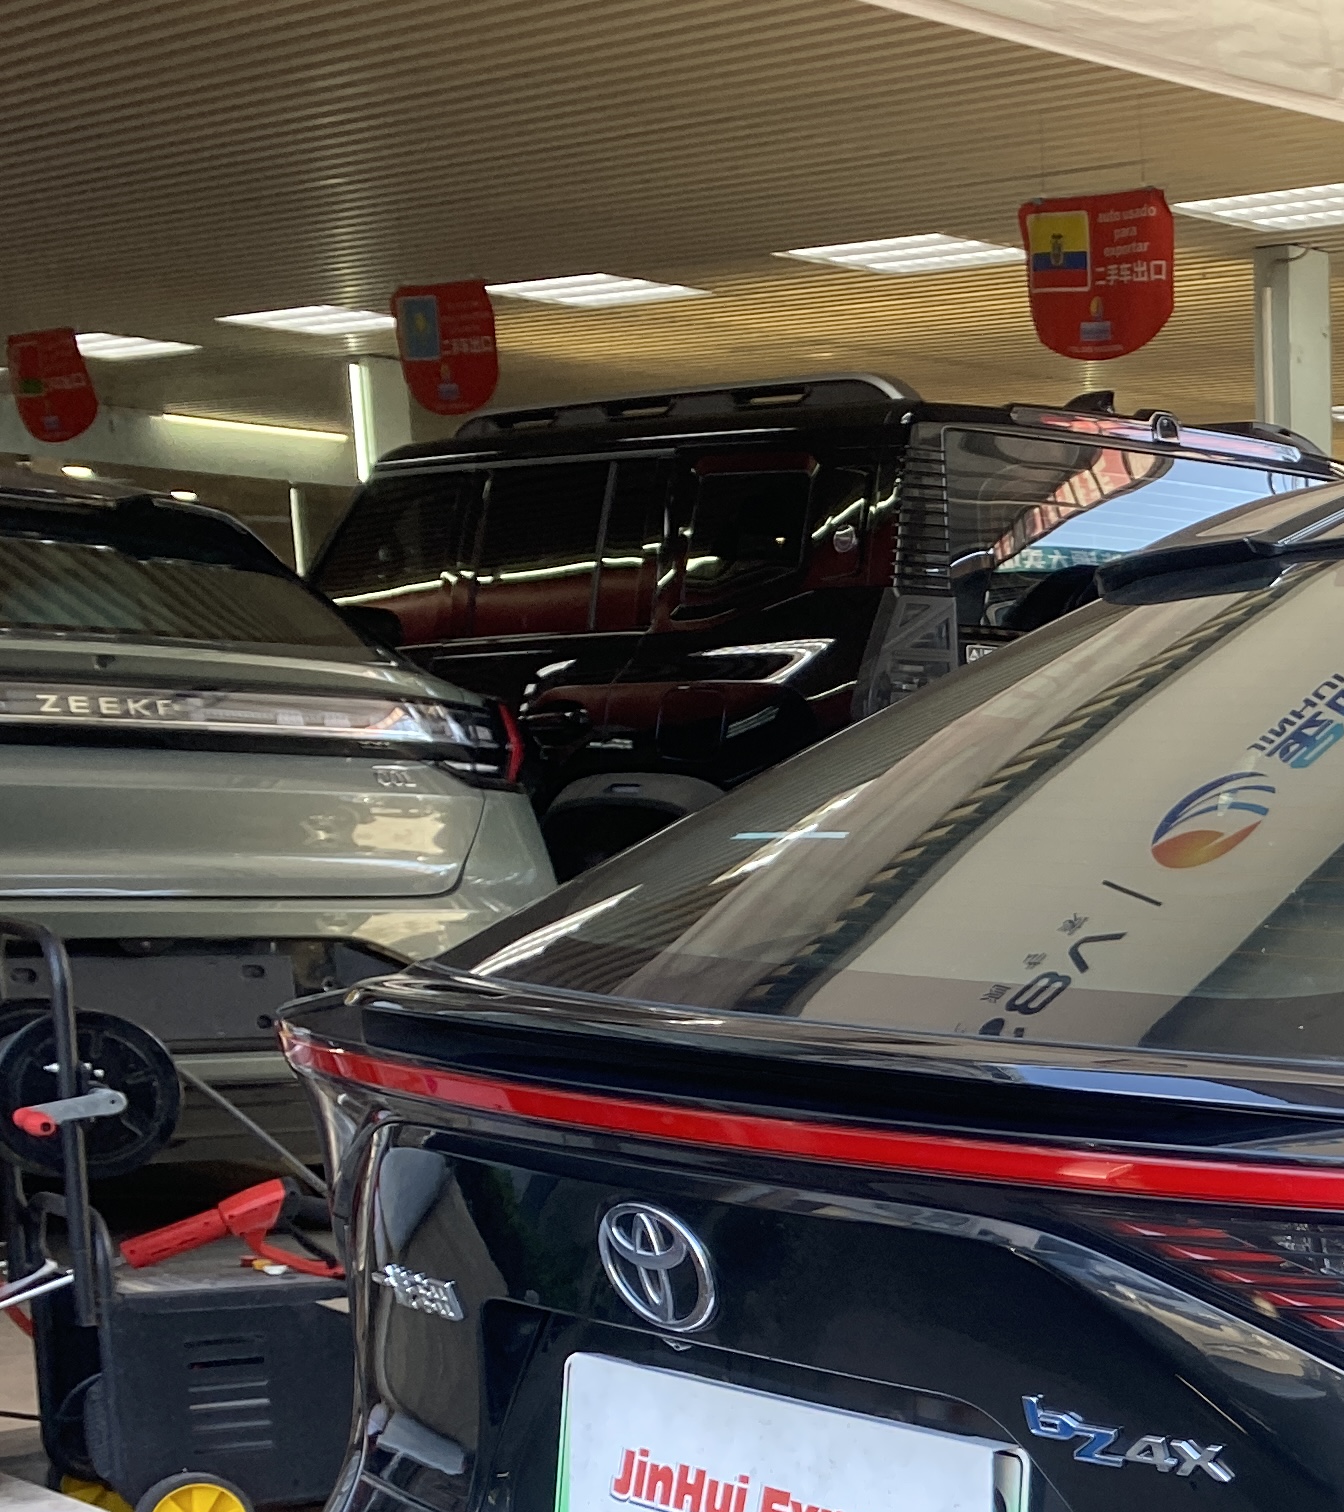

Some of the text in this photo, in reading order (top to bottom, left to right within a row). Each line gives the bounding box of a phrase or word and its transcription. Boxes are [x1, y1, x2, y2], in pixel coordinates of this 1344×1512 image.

[1094, 259, 1167, 286] 二手车出口
